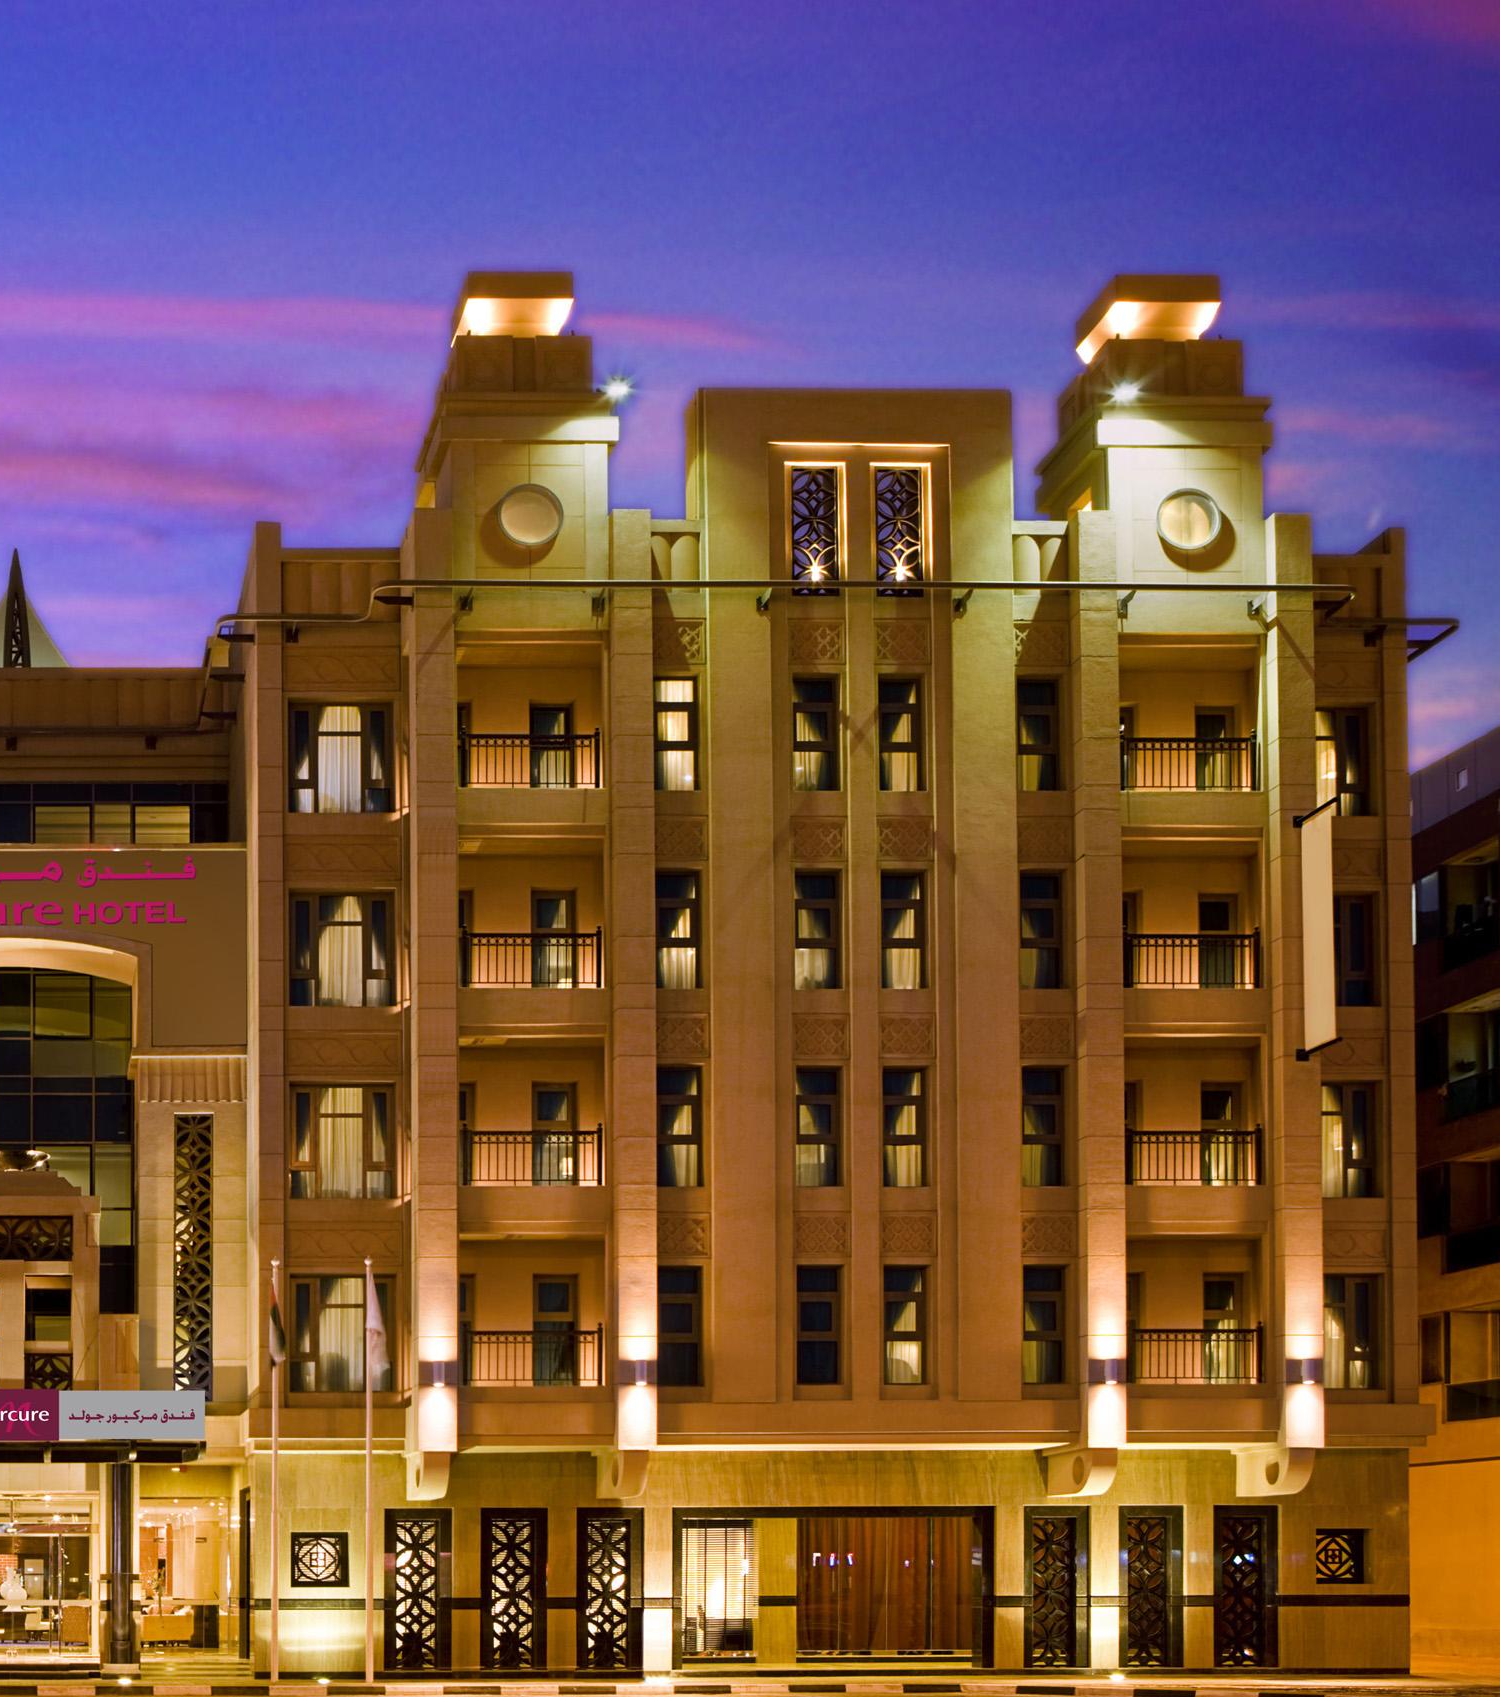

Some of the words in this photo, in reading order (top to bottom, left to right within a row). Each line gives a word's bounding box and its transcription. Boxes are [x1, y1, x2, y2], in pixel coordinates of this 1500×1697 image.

[76, 855, 197, 888] فندق
[72, 901, 187, 924] HOTEL
[68, 1409, 105, 1424] جولد
[106, 1409, 158, 1424] مركيور
[160, 1408, 196, 1424] فندق
